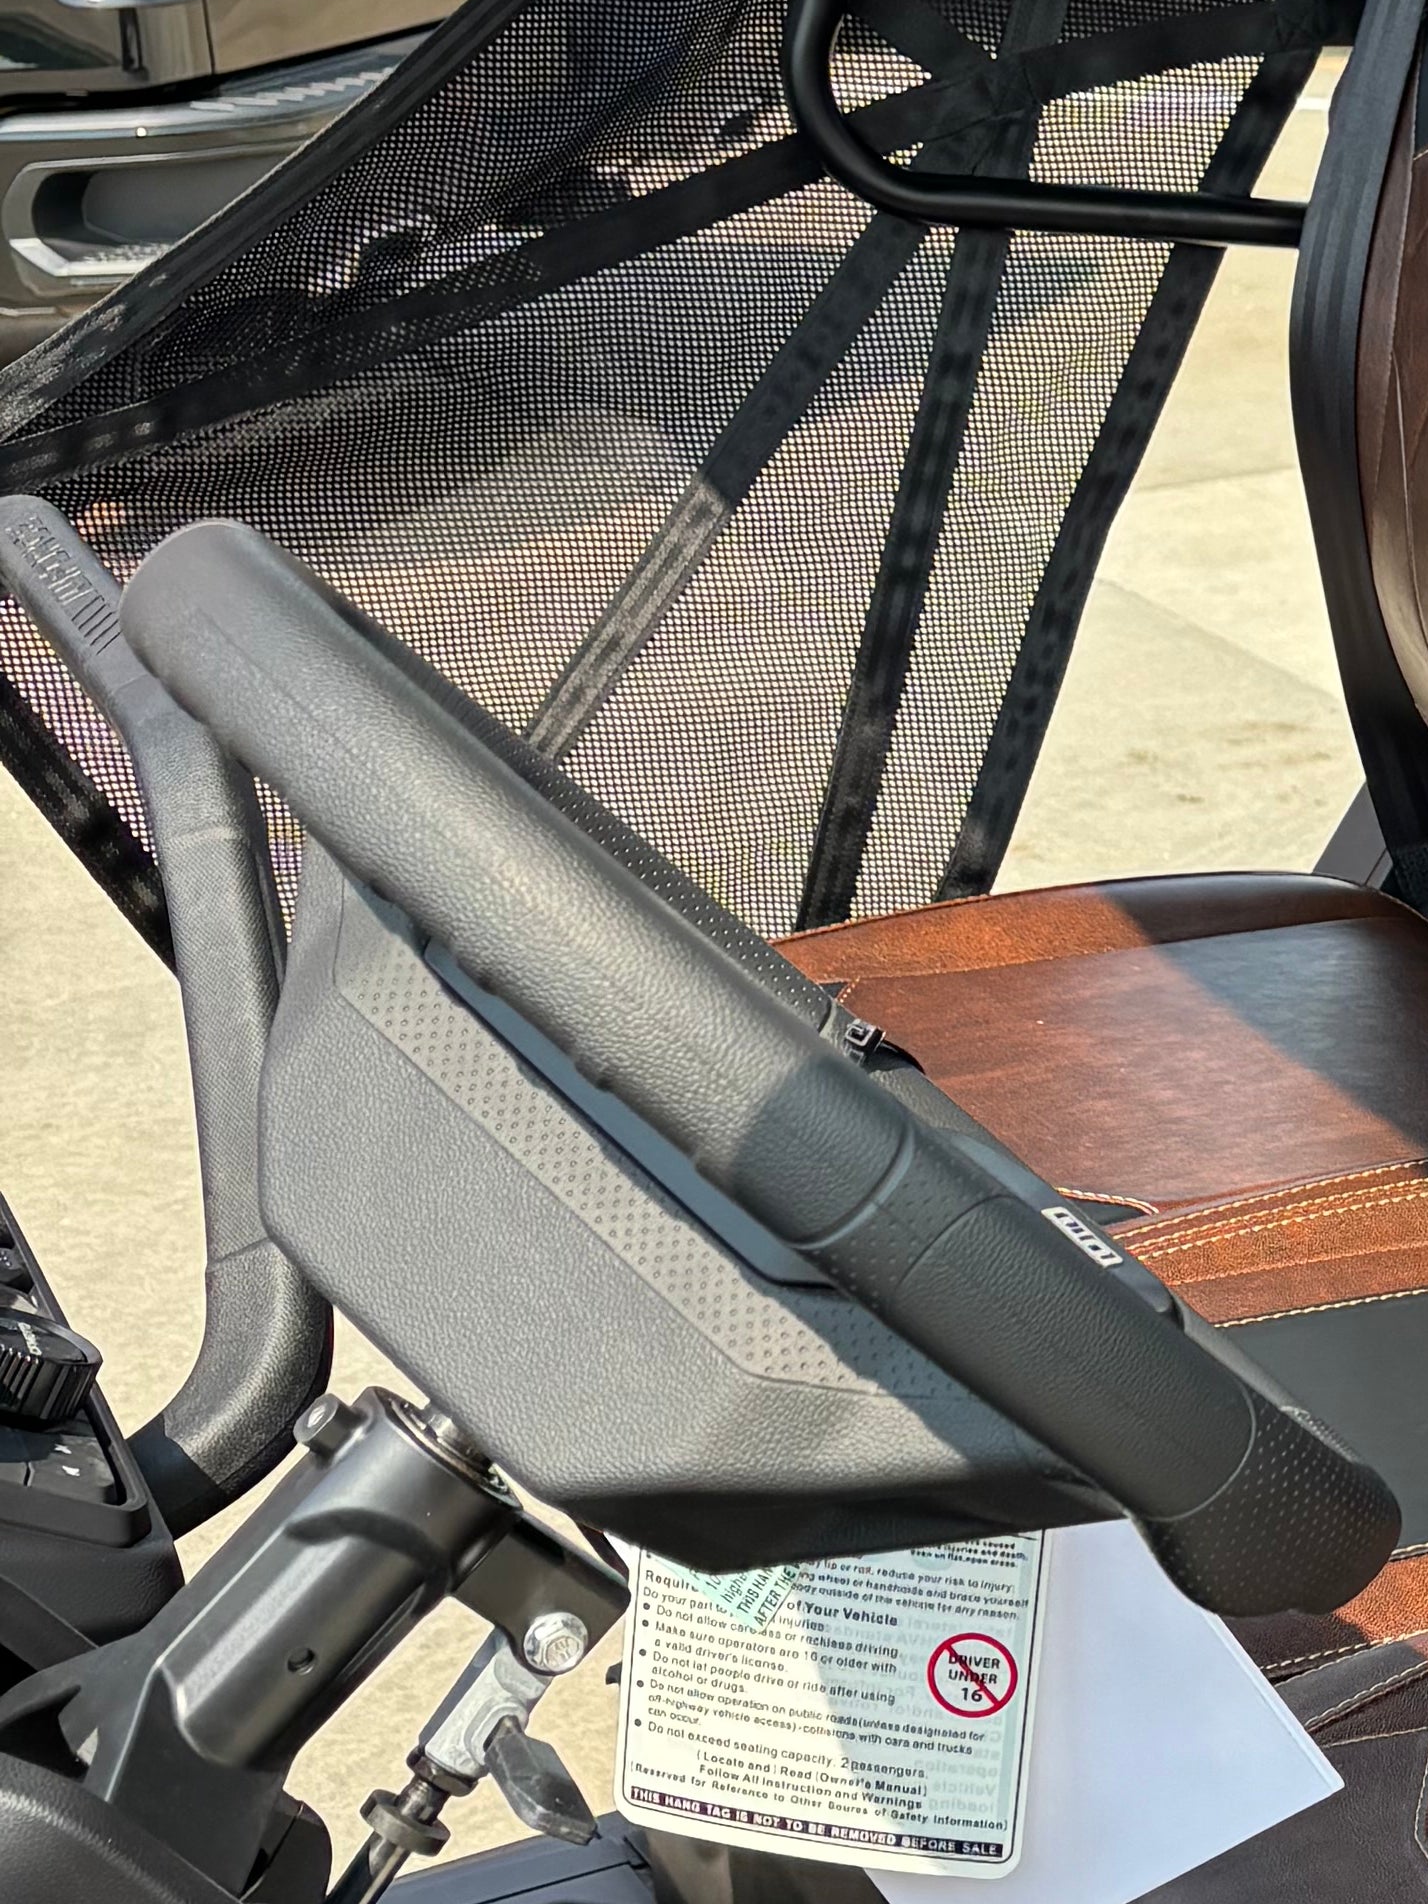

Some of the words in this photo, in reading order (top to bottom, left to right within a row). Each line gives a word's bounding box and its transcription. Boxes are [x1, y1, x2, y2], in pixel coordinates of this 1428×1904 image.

[643, 1586, 658, 1599] Do
[662, 1593, 686, 1606] your
[657, 1605, 672, 1617] Do
[675, 1611, 693, 1622] not
[697, 1616, 726, 1629] allow
[805, 1600, 839, 1618] Your
[843, 1607, 898, 1627] Vehicle
[653, 1651, 668, 1664] Do
[671, 1656, 690, 1668] not
[754, 1673, 784, 1687] drive
[949, 1654, 1001, 1671] DRIVER
[948, 1670, 998, 1685] UNDER
[650, 1679, 664, 1691] Do
[772, 1705, 786, 1714] on
[961, 1687, 983, 1703] 16
[648, 1721, 664, 1734] Do
[667, 1727, 684, 1738] not
[913, 1740, 935, 1751] and
[748, 1760, 770, 1773] and
[780, 1766, 812, 1780] Read
[700, 1763, 738, 1781] Follow
[835, 1790, 858, 1801] and
[633, 1788, 660, 1803] THIS
[665, 1795, 700, 1813] HANG
[706, 1804, 731, 1819] TAG
[736, 1810, 748, 1823] IS
[753, 1813, 780, 1828] NOT
[785, 1818, 803, 1832] TO
[808, 1823, 825, 1835] BE
[831, 1826, 897, 1846] REMOVED
[901, 1836, 956, 1853] BEFORE
[962, 1842, 998, 1856] SALE
